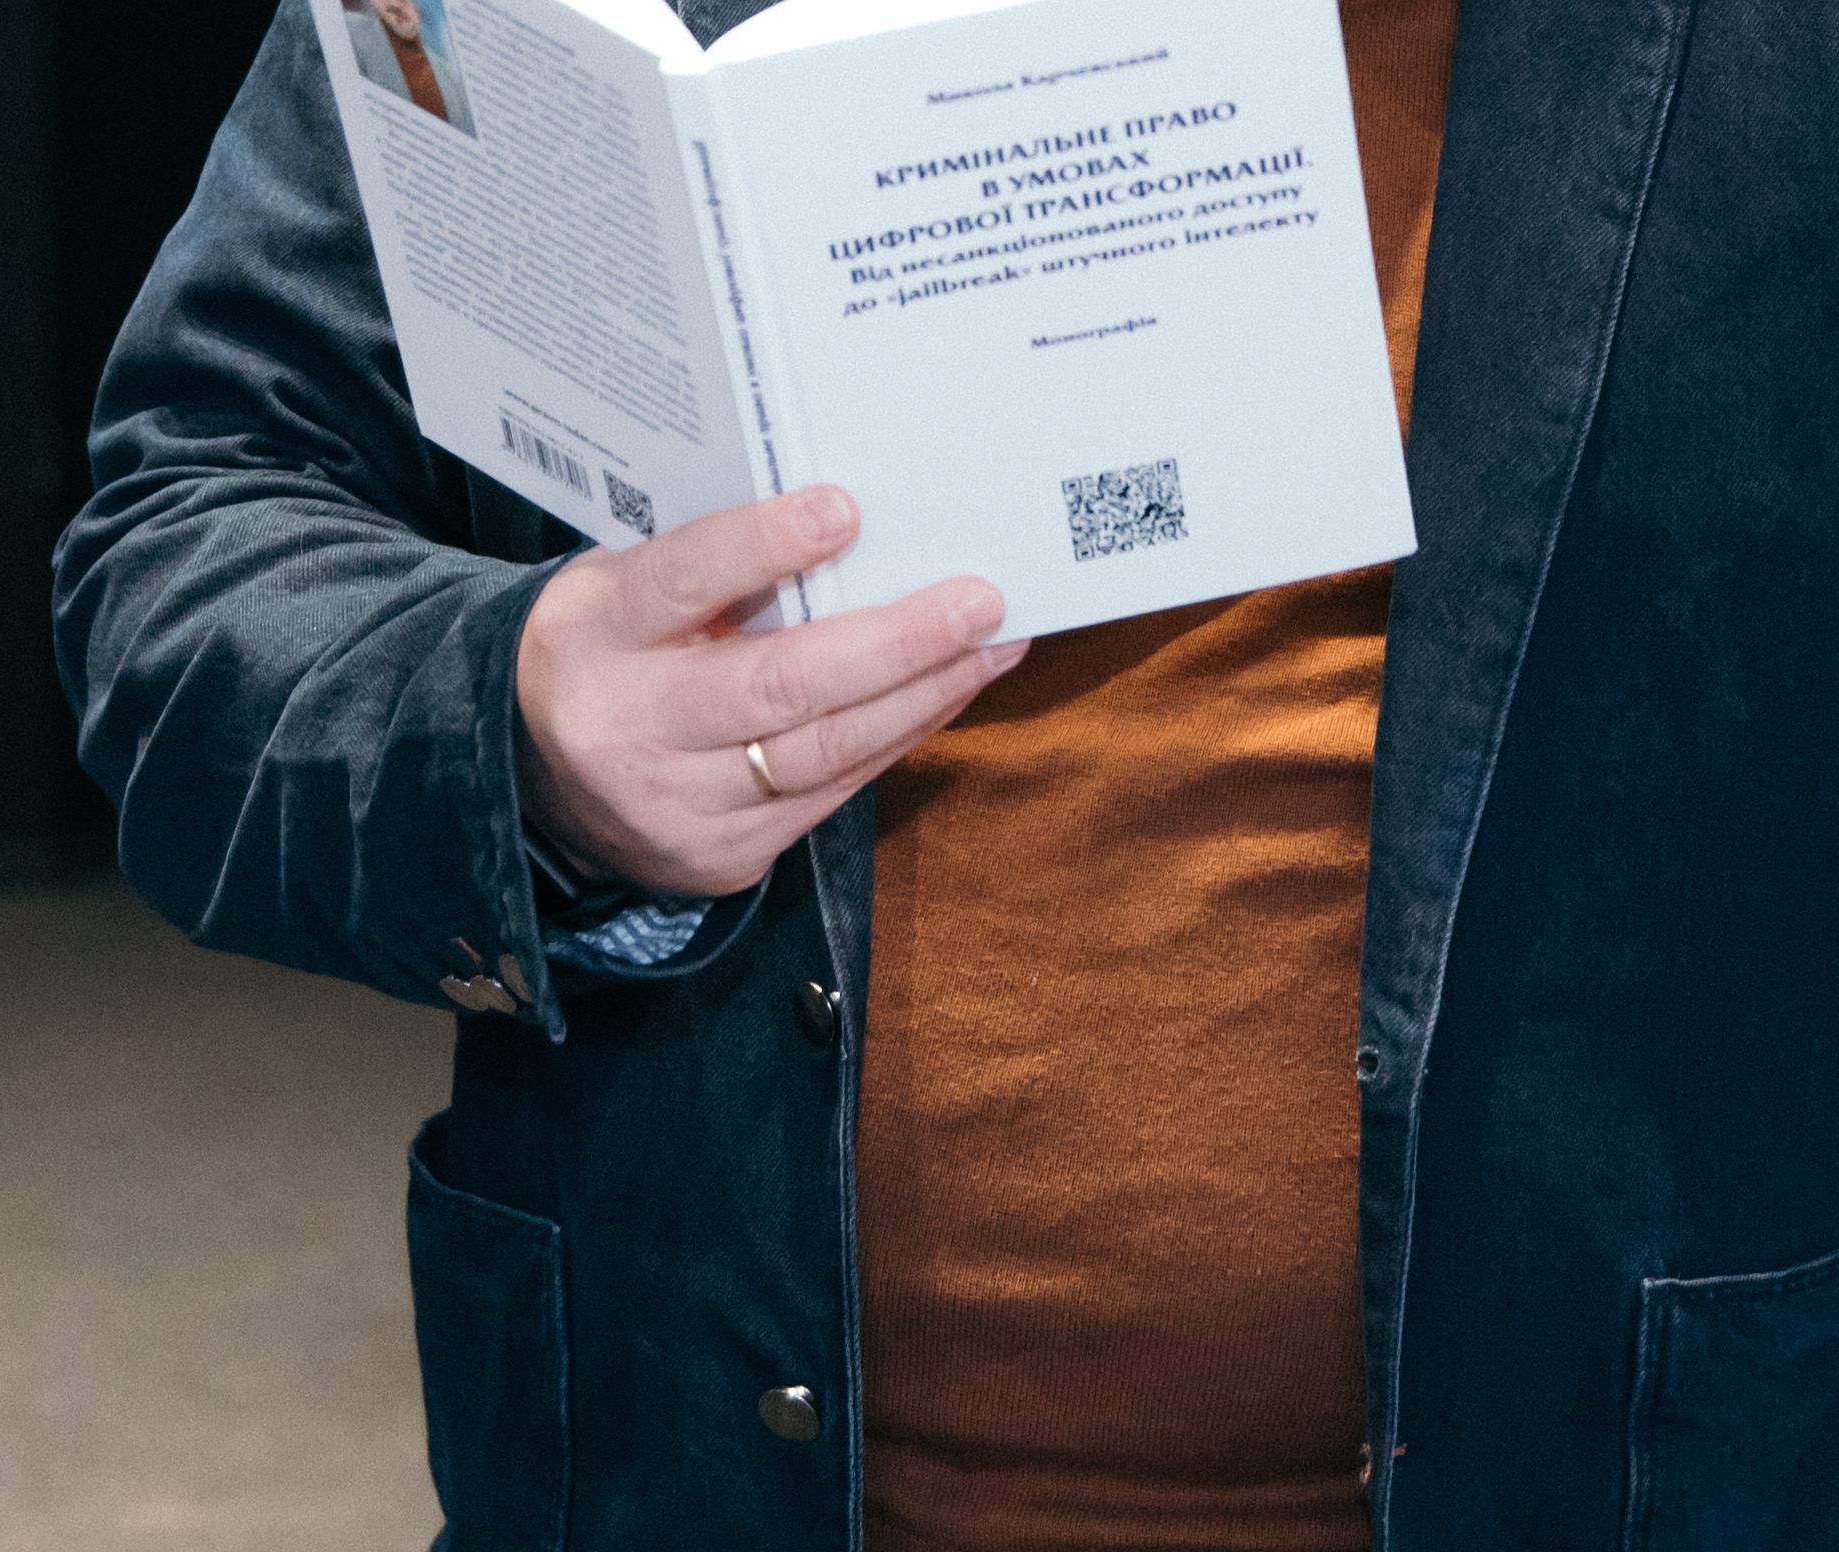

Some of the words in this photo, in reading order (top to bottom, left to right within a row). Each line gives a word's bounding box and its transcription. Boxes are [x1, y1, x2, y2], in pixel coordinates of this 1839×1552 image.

[875, 125, 1111, 189] КРИМІНАЛЬНЕ
[1123, 100, 1237, 139] ПРАВО
[981, 179, 1000, 198] В
[1008, 149, 1151, 193] УМОВАХ
[828, 202, 1013, 262] ЦИФРОВОЇ
[843, 297, 878, 318] до
[1041, 237, 1176, 275] штучного
[1184, 210, 1319, 246] інтелекту
[850, 264, 895, 285] Від
[901, 208, 1185, 274] несанкціонованого
[1193, 185, 1302, 219] доступу
